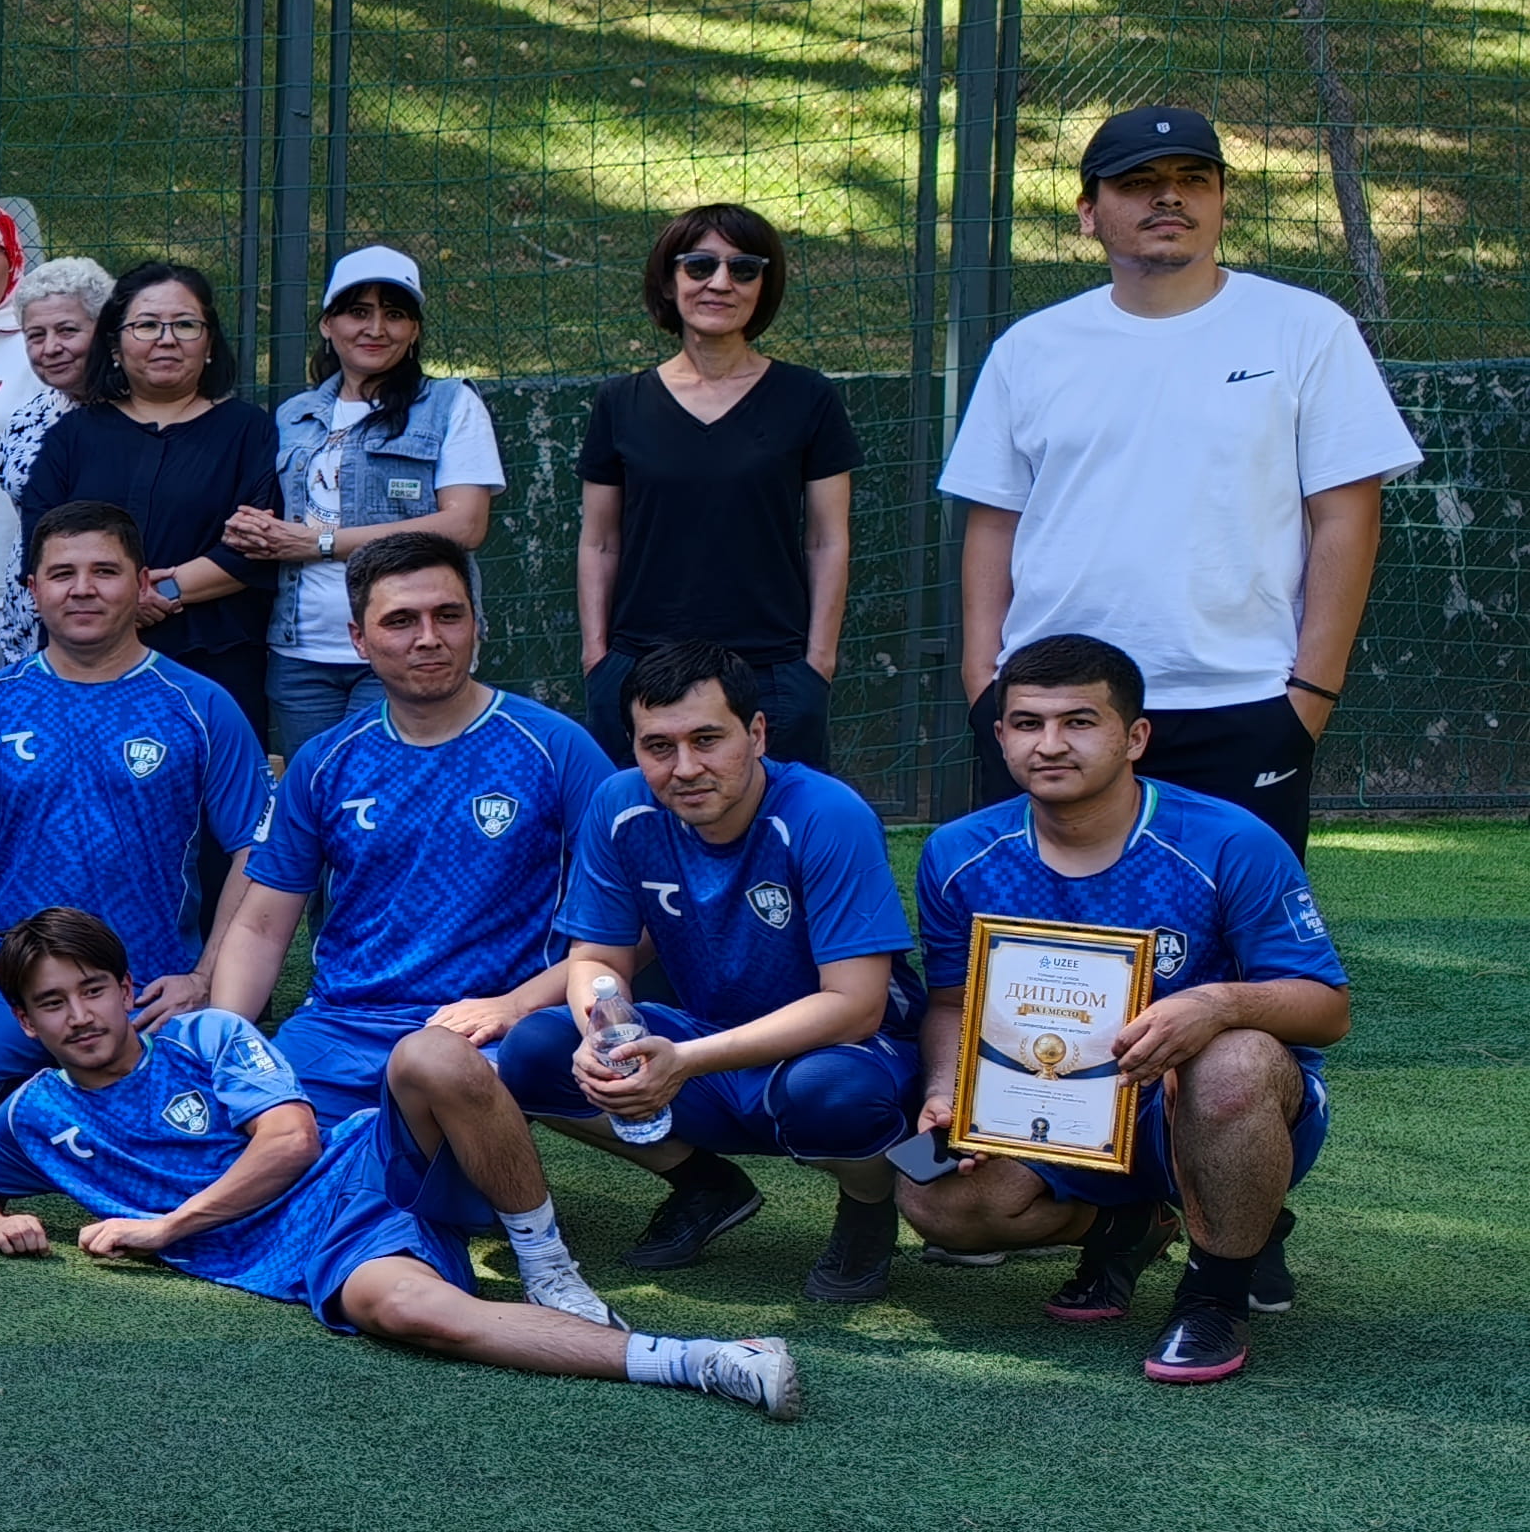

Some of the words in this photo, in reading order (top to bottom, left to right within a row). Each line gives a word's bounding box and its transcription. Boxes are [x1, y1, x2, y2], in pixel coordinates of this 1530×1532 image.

[130, 744, 158, 762] UFA
[480, 800, 510, 818] UFA
[754, 890, 787, 909] UFA
[1053, 957, 1080, 969] UZEE
[1004, 982, 1107, 1009] ДИПЛОМ
[170, 1098, 204, 1123] UFA
